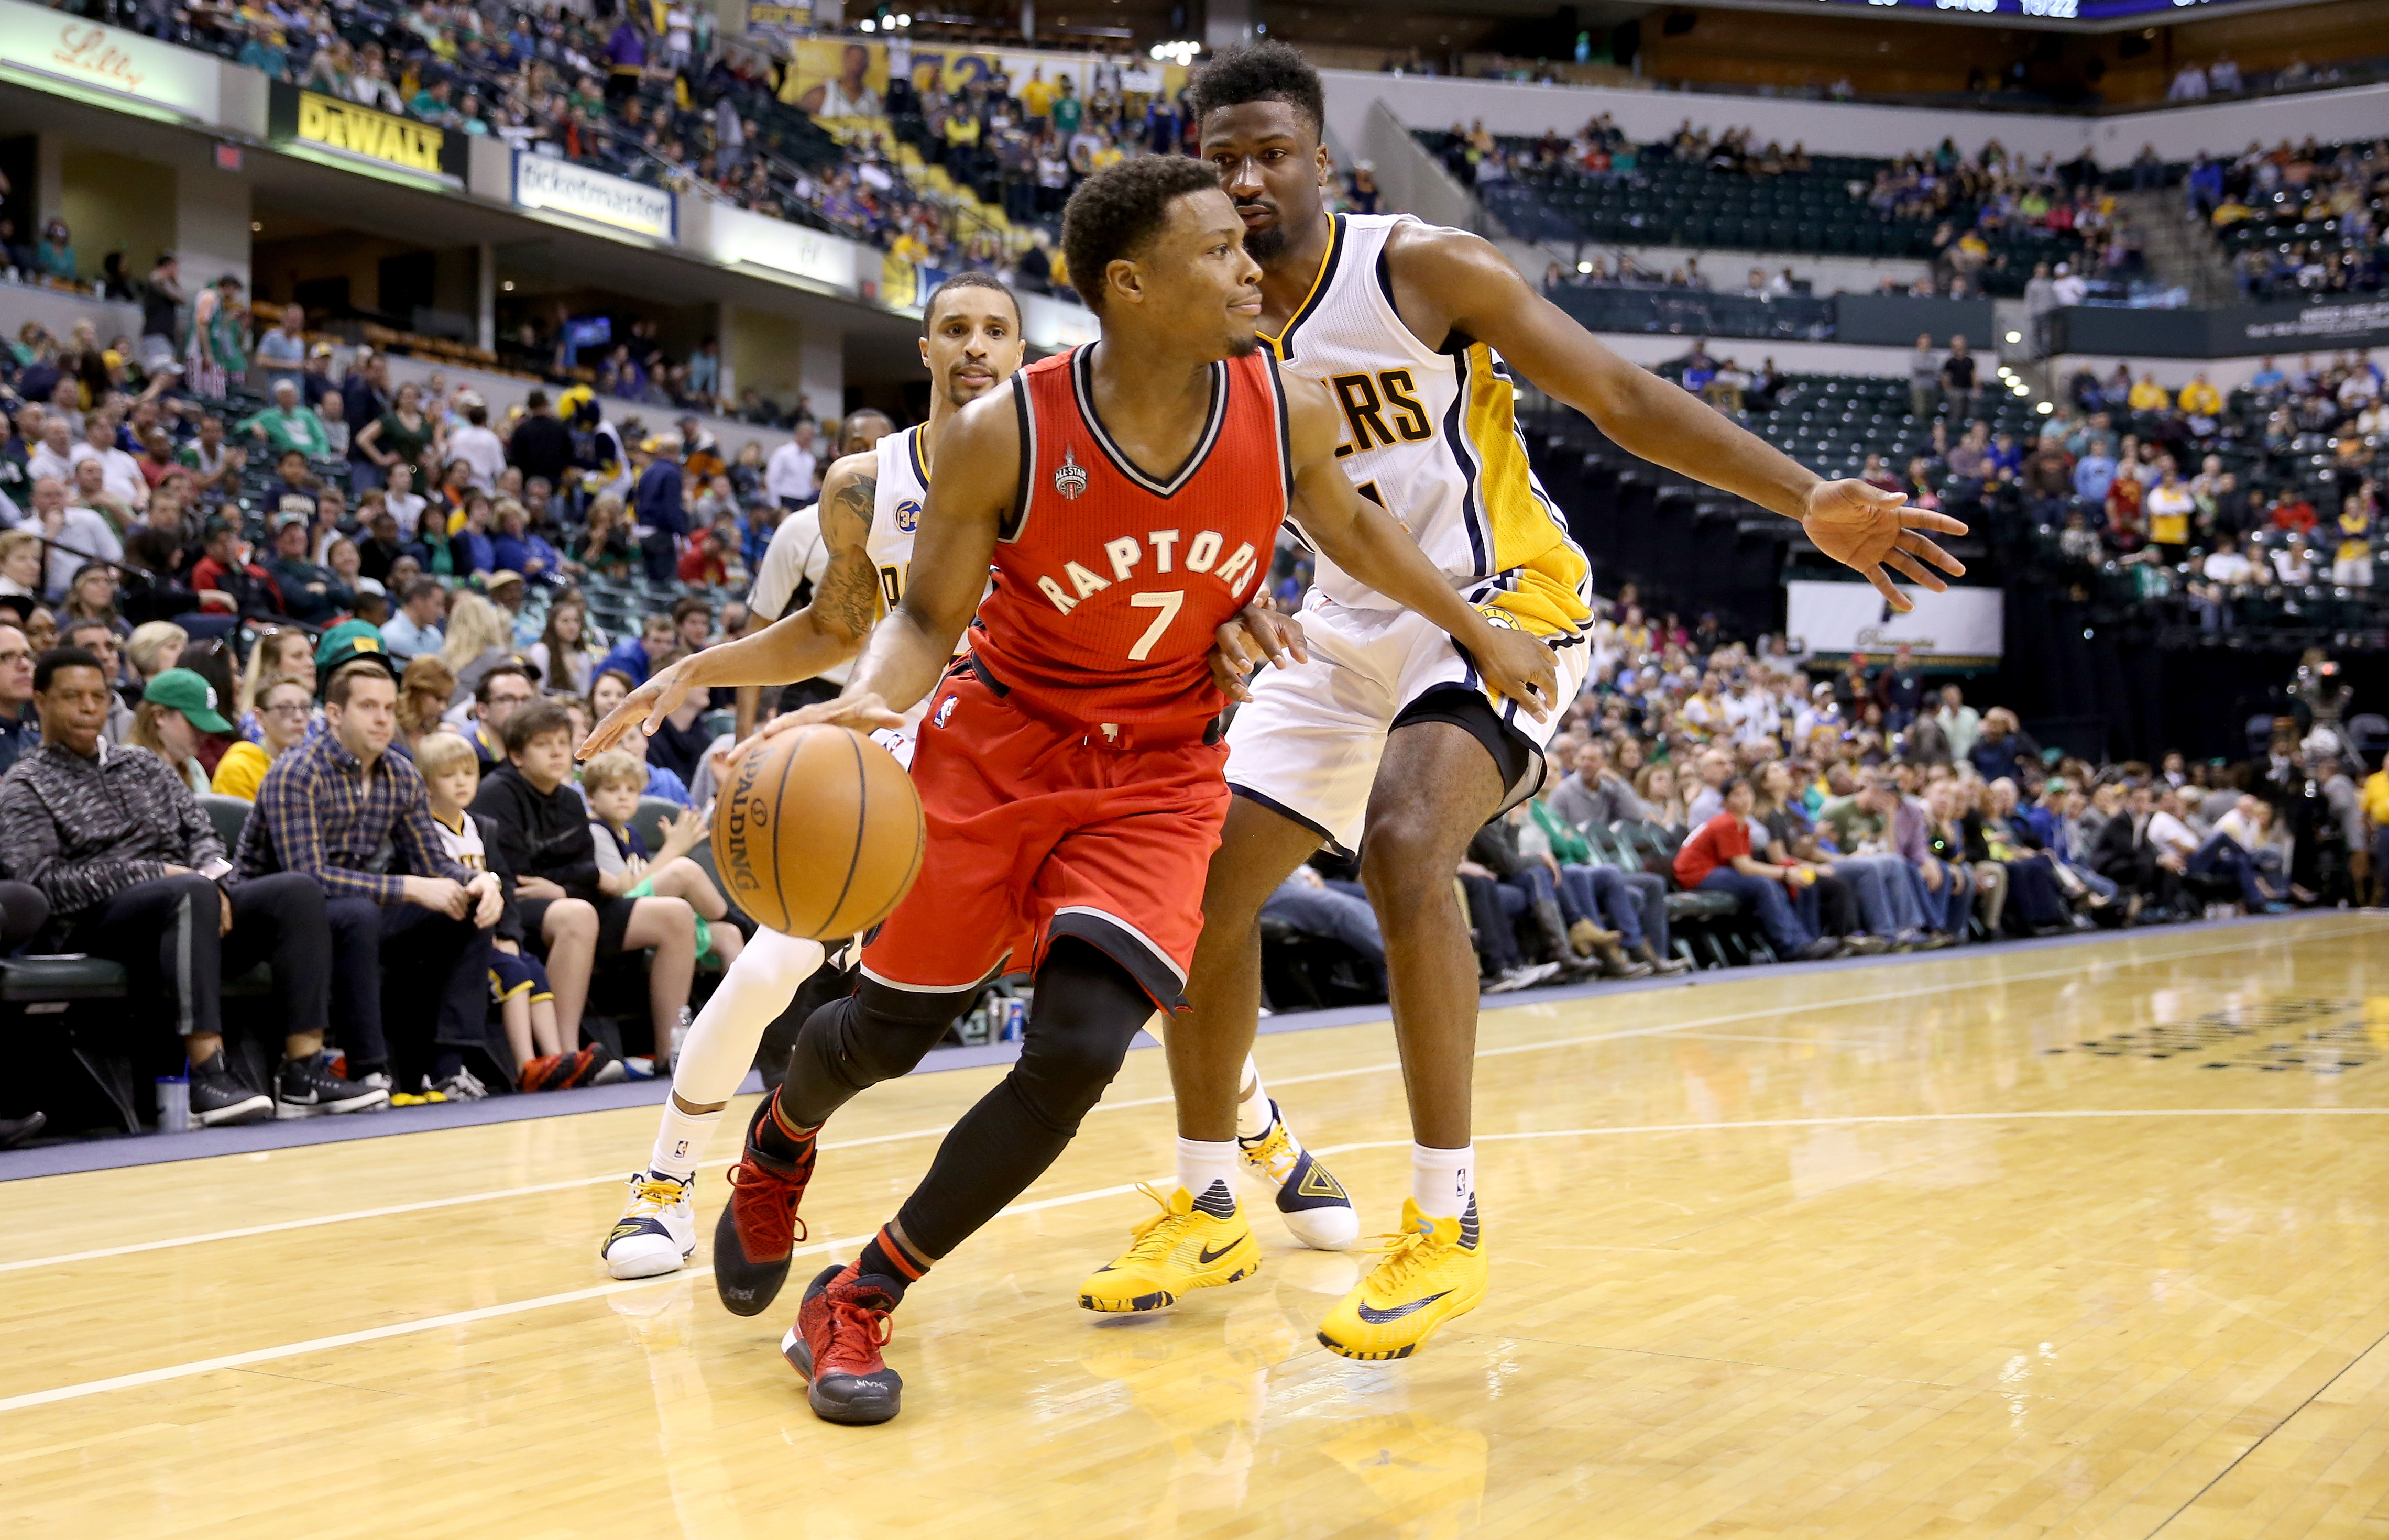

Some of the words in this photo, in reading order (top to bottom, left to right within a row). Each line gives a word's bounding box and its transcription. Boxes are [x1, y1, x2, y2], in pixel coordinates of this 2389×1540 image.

[52, 24, 146, 92] Lilly
[525, 163, 667, 222] ticketmaster
[900, 510, 920, 527] 34
[1036, 529, 1257, 616] RAPTORS
[1128, 590, 1184, 661] 7
[729, 747, 775, 890] SPALDING
